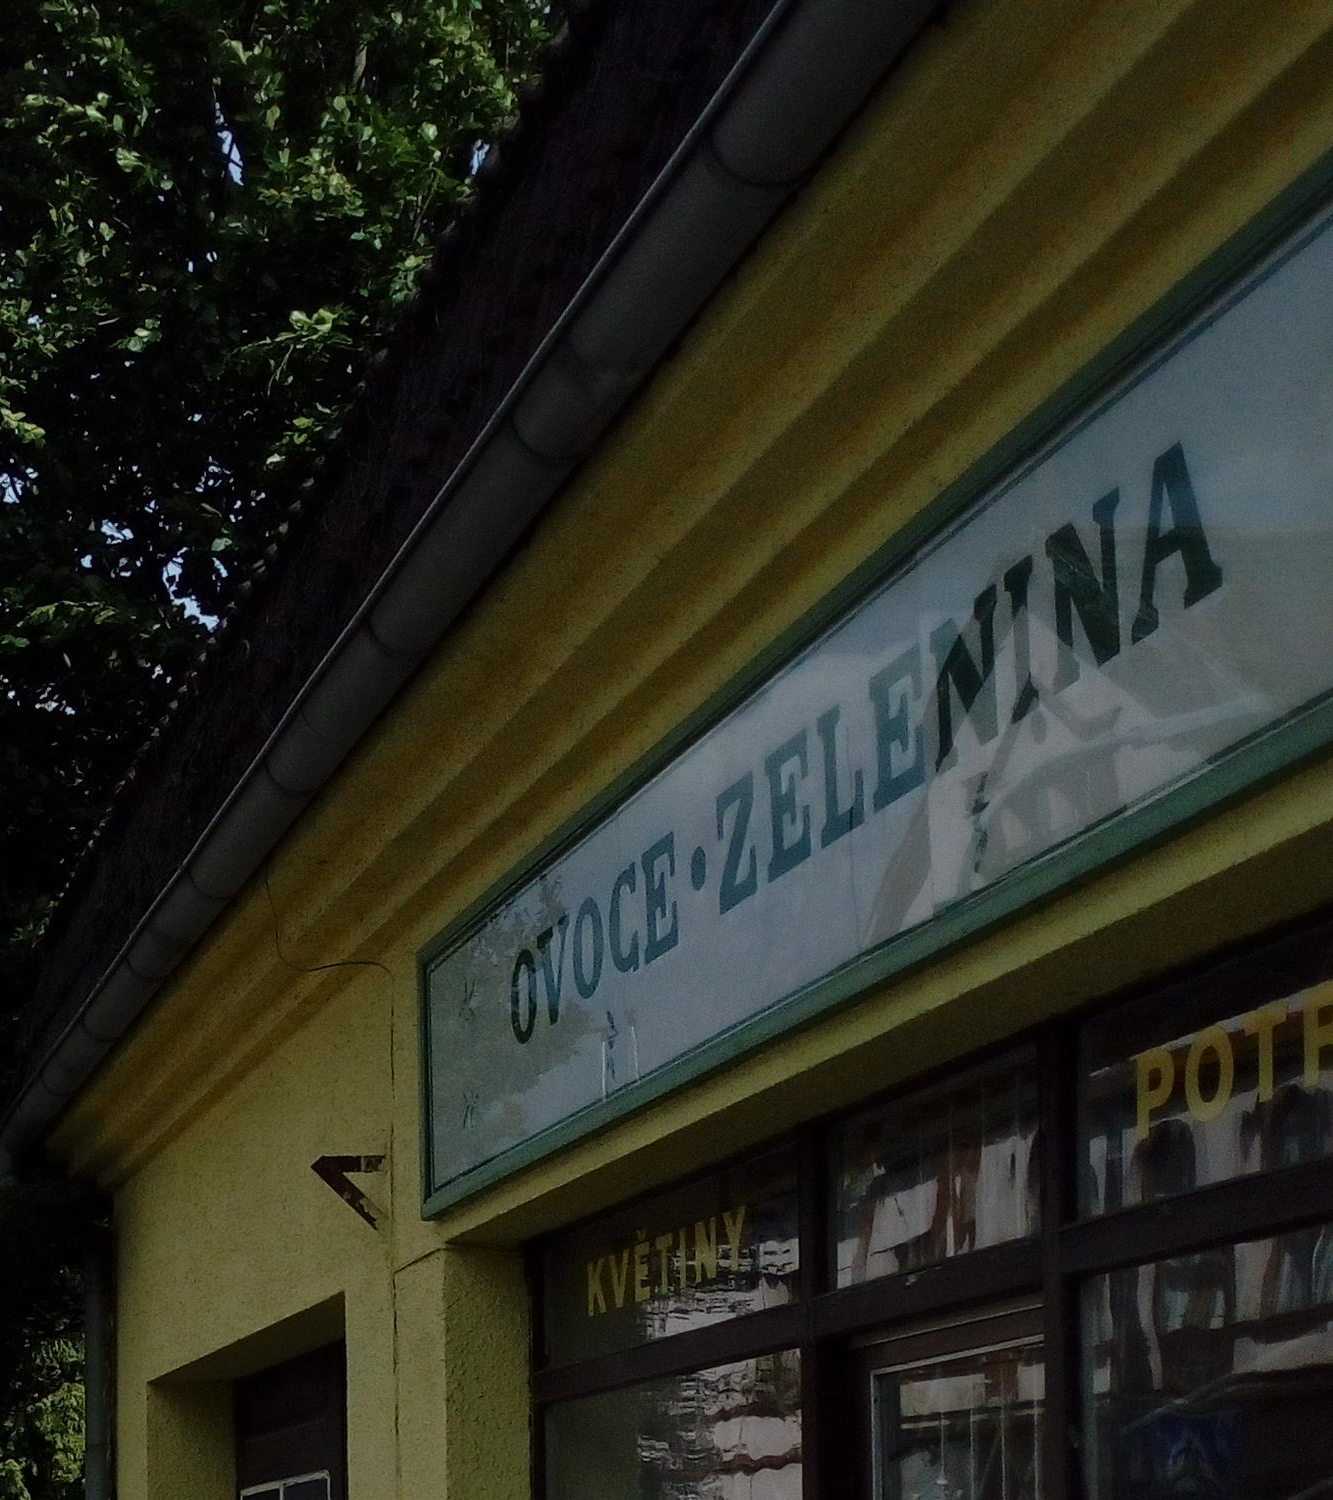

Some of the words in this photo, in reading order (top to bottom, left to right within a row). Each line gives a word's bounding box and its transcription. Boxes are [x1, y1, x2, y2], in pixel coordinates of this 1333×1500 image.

[511, 832, 679, 1045] OVOCE
[716, 441, 1223, 916] ZELENINA
[587, 1205, 747, 1317] KVĚTINY
